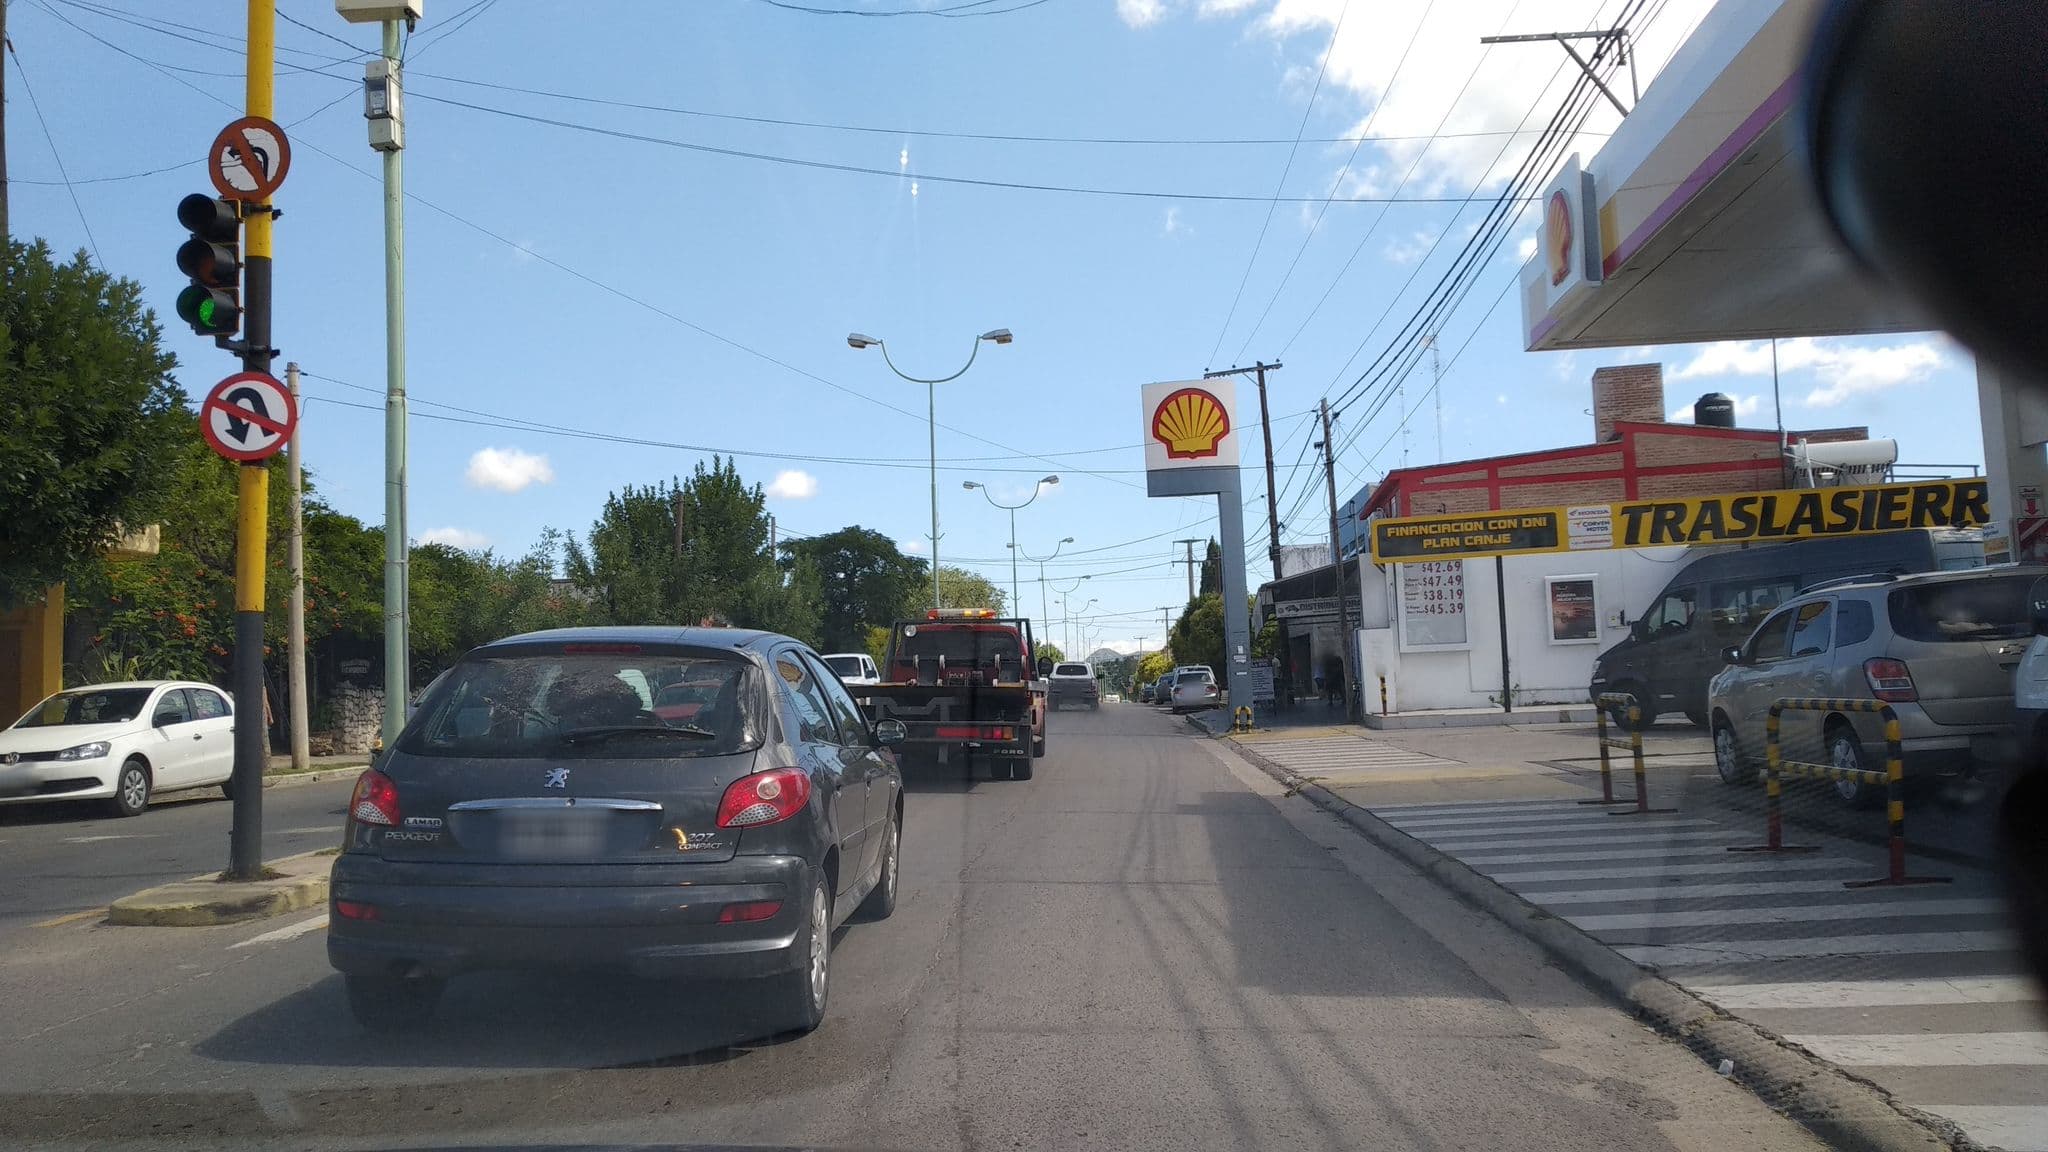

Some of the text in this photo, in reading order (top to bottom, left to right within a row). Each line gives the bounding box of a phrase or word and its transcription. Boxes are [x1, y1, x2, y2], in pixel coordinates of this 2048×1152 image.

[1387, 516, 1547, 537] FINANCIACION CON DNI
[1423, 533, 1512, 549] PLAN CANJE
[1422, 561, 1461, 573] $42.69
[1423, 575, 1462, 587] $47.49
[1423, 588, 1463, 601] $38.19
[1424, 602, 1464, 615] $45.39
[406, 818, 441, 826] LAMAR
[687, 832, 715, 842] 207
[678, 842, 723, 850] COMPACT
